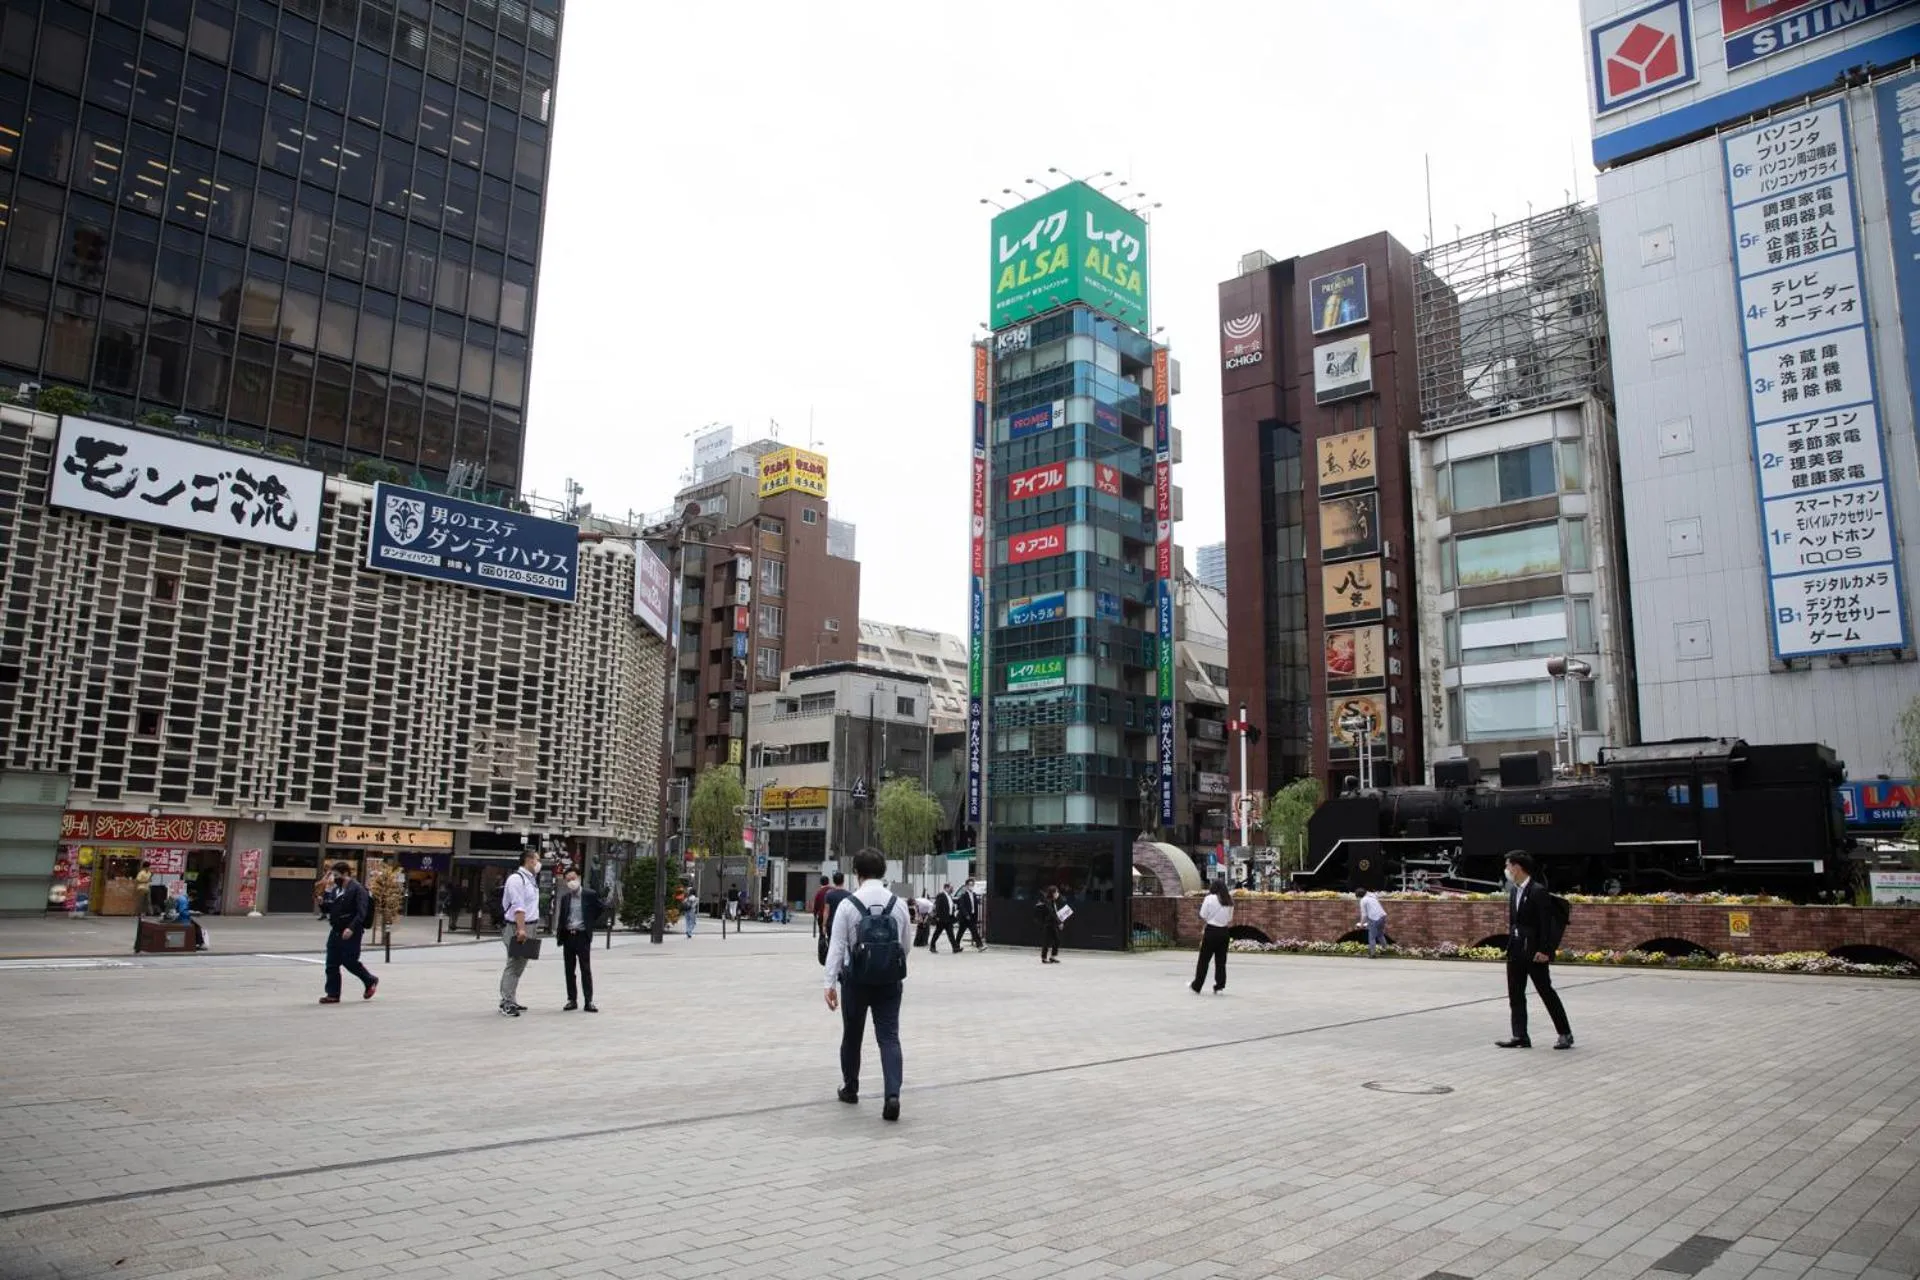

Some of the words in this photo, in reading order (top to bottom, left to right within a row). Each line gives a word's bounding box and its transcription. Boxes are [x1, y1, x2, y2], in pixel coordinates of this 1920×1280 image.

[1756, 115, 1818, 145] パソコン
[1757, 132, 1820, 160] プリンタ
[1733, 163, 1752, 178] 6F
[1758, 142, 1838, 178] パソコン周辺機器
[1760, 160, 1838, 193] パソコンサプライ
[1762, 186, 1833, 217] 調理家電
[1764, 203, 1835, 234] 照明器具
[999, 209, 1068, 264] レイク
[1086, 211, 1140, 262] レイク
[1739, 233, 1759, 248] 5F
[1766, 221, 1837, 250] 企業法人
[1767, 236, 1838, 264] 専用窓口
[997, 243, 1069, 294] ALSA
[1084, 247, 1143, 296] ALSA
[1771, 271, 1817, 295] テレビ
[1773, 284, 1854, 312] レコーダー
[1746, 304, 1767, 320] 4F
[1775, 298, 1856, 328] オーディオ
[1226, 351, 1262, 369] ICHIGO
[1778, 344, 1838, 368] 冷蔵庫
[1780, 362, 1840, 385] 洗濯機
[1754, 378, 1774, 394] 3F
[1782, 379, 1842, 402] 掃除機
[1787, 412, 1857, 435] エアコン
[1788, 429, 1861, 453] 季節家電
[1762, 453, 1784, 469] 2F
[1789, 450, 1843, 471] 理美容
[63, 436, 298, 532] モンゴ流
[1013, 469, 1063, 496] アイフル
[1097, 480, 1118, 494] アイフル
[1791, 465, 1865, 490] 健康家電
[1159, 474, 1168, 511] アイフル
[1795, 490, 1879, 513] スマートフォン
[431, 506, 517, 537] 男のエステ
[1796, 509, 1883, 532] モバイルアクセサリー
[1027, 534, 1059, 553] アコム
[1771, 529, 1792, 545] 1F
[1799, 528, 1875, 547] ヘッドホン
[382, 547, 437, 565] ダンディハウス
[427, 527, 569, 574] ダンディハウス
[1801, 547, 1862, 565] IQOS
[496, 568, 564, 589] 0120-552-011
[1803, 572, 1888, 594] デジタルカメラ
[1778, 607, 1801, 623] B1
[1806, 595, 1860, 613] デジカメ
[1013, 608, 1054, 624] セントラル
[1808, 608, 1890, 627] アクセサリー
[1811, 628, 1860, 645] ゲーム
[1011, 662, 1061, 678] レイクALSA
[971, 720, 979, 773] かんべ土地
[1161, 723, 1171, 775] かんべ土地
[96, 815, 194, 840] ジャンボ宝くじ
[198, 820, 226, 842] 発売中
